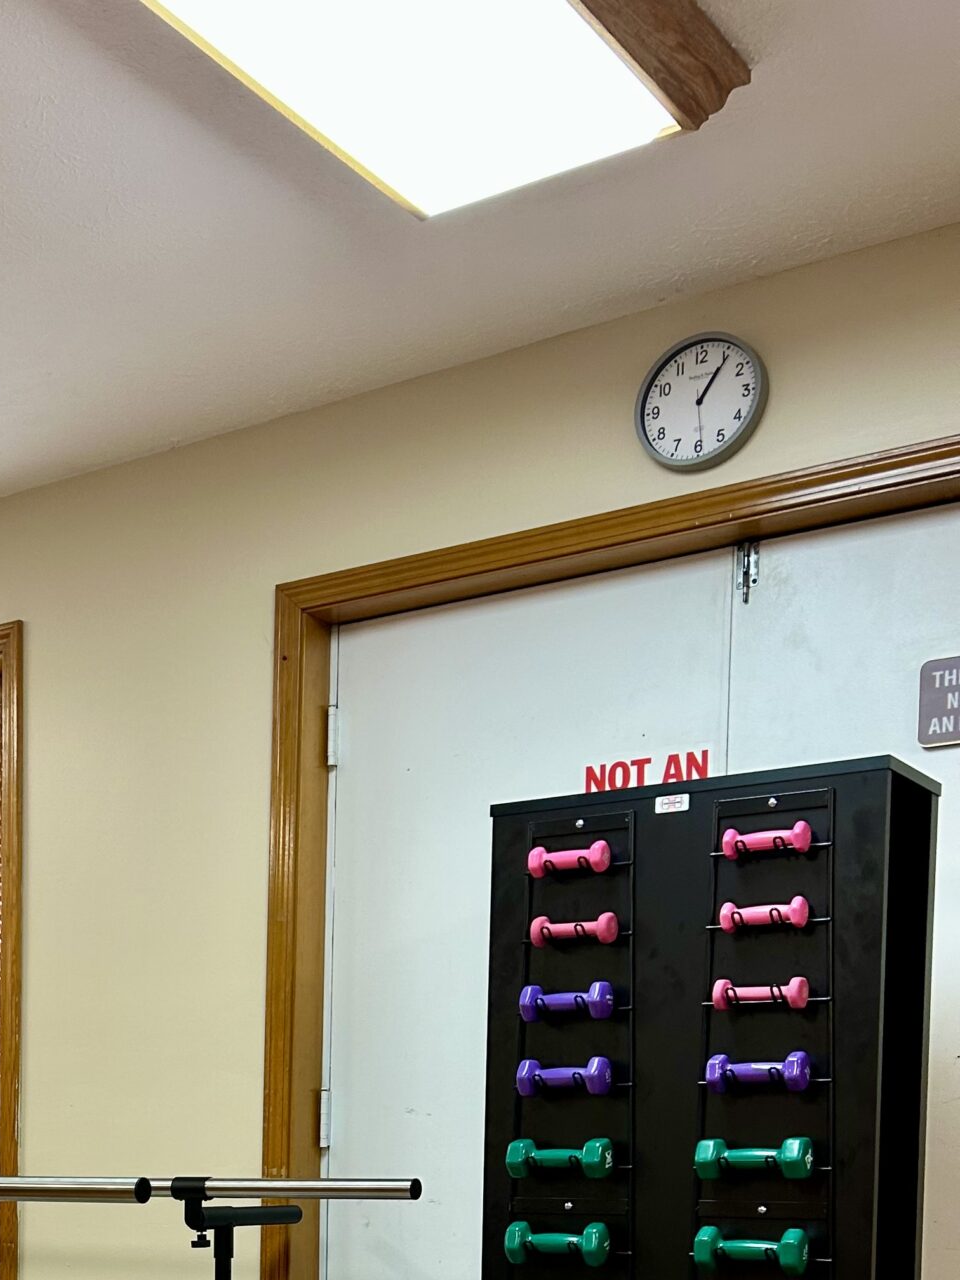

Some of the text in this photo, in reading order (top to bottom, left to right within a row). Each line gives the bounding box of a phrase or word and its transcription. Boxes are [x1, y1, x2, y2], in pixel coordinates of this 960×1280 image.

[695, 349, 709, 365] 12
[676, 362, 685, 376] 11
[735, 362, 744, 377] 2
[659, 382, 672, 397] 10
[742, 383, 751, 397] 3
[651, 406, 660, 420] 9
[733, 408, 742, 421] 4
[657, 427, 666, 440] 8
[716, 429, 725, 442] 5
[673, 439, 682, 452] 7
[694, 440, 703, 453] 6
[932, 668, 960, 688] TH
[928, 715, 954, 735] AN
[585, 749, 709, 793] NOT AN
